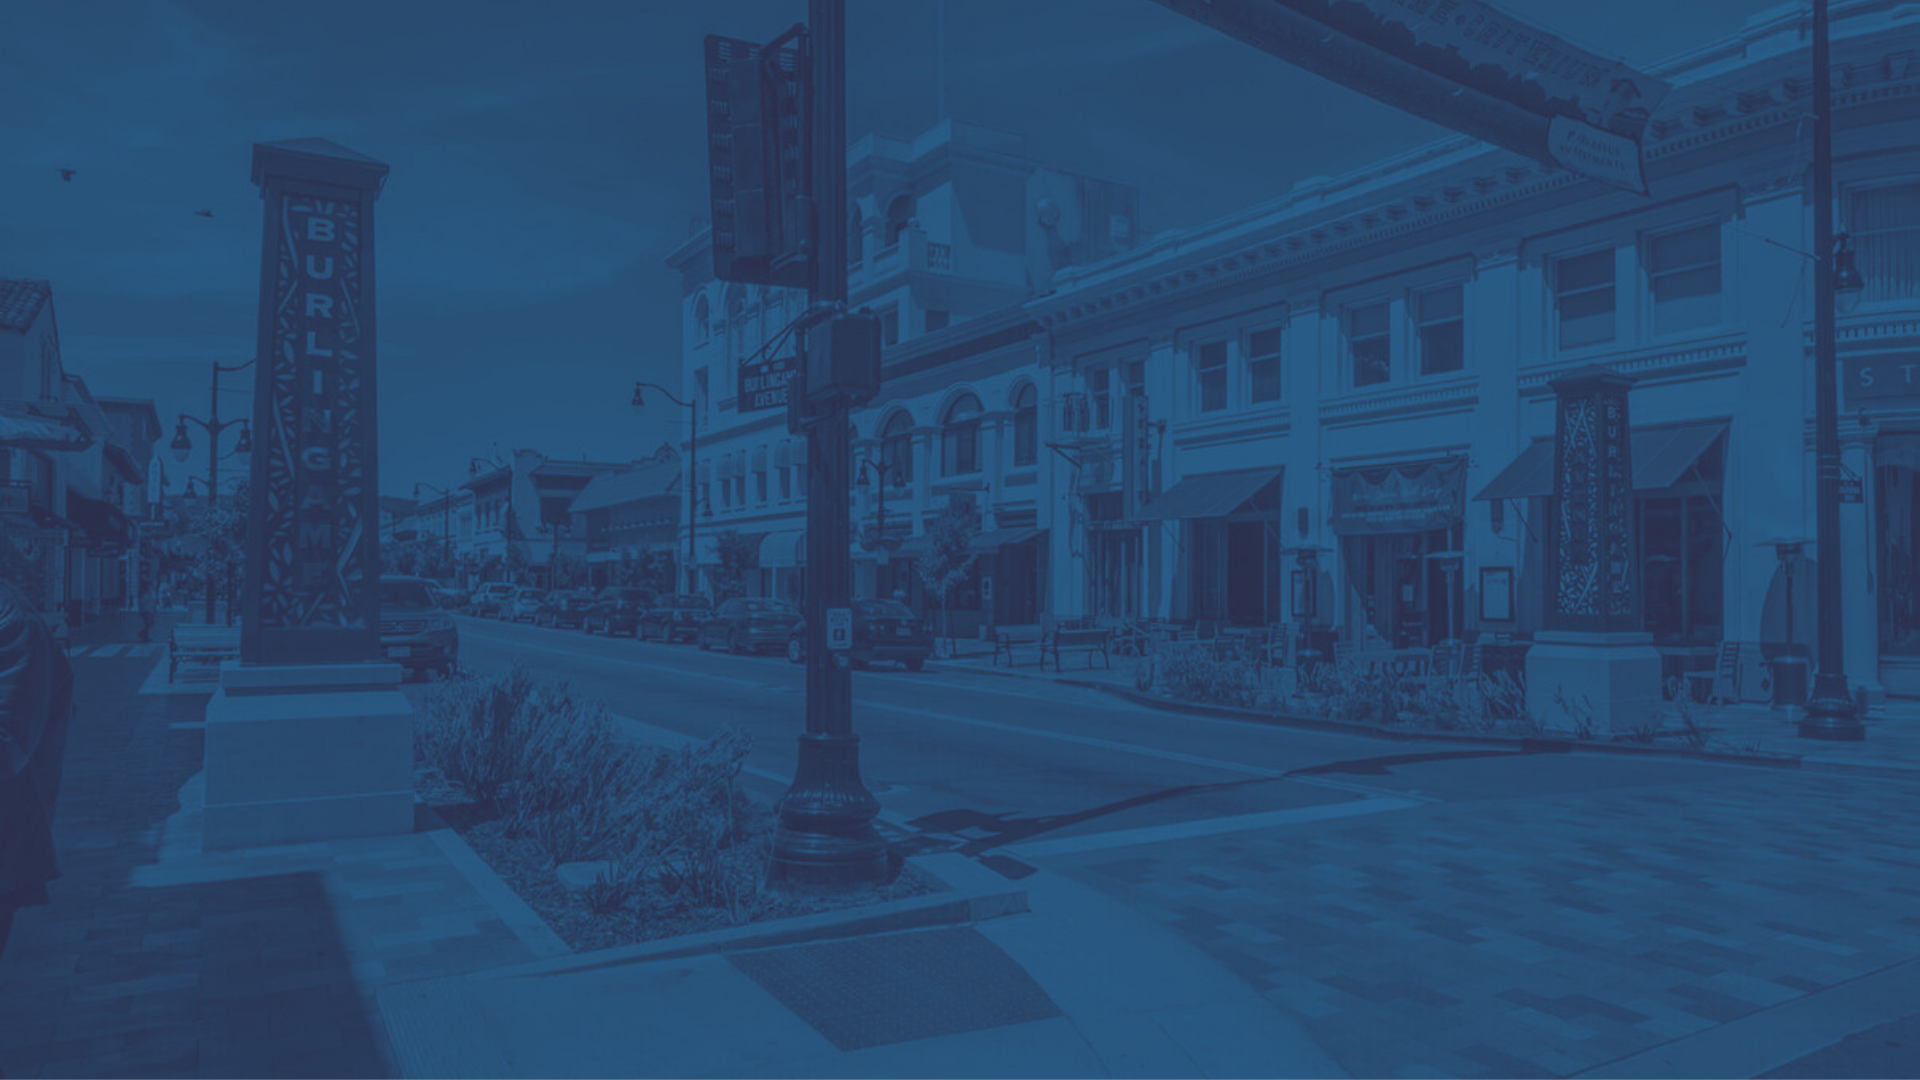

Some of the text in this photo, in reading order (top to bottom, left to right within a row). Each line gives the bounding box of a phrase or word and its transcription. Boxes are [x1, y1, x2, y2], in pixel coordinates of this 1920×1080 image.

[744, 369, 796, 392] BURLINGAM
[299, 216, 336, 585] BURLINGAME
[754, 388, 789, 407] AVENUE
